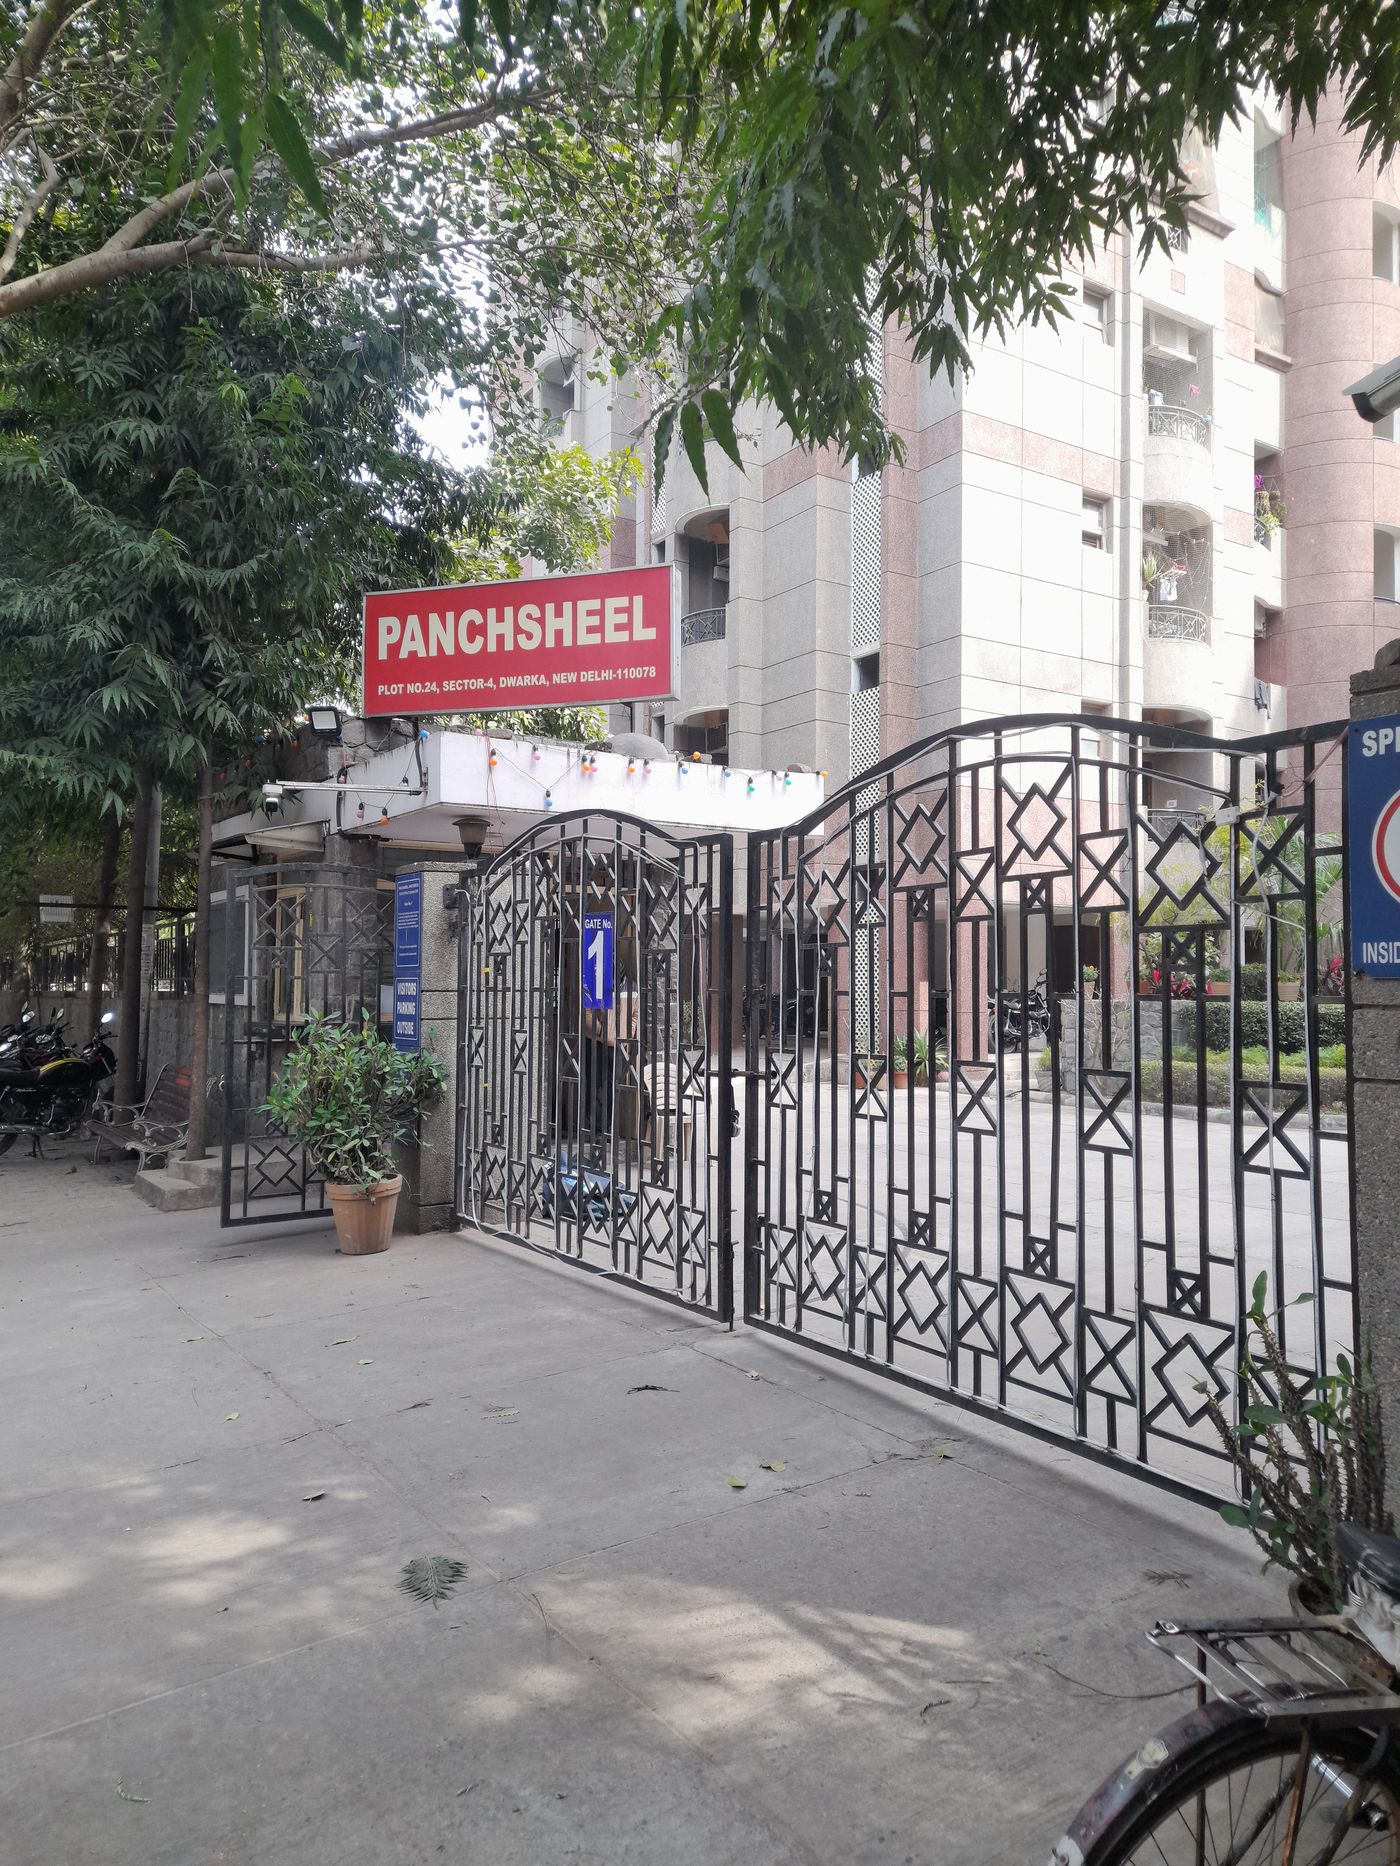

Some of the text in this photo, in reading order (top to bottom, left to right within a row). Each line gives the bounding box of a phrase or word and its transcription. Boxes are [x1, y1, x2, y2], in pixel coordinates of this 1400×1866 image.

[378, 595, 657, 661] PANCHSHEEL
[378, 666, 656, 696] PLOT NO.24, SECTOR-4, DWARKA, NEW DELHI-110078
[584, 919, 613, 929] GATE No.
[588, 930, 604, 1000] 1
[397, 982, 417, 996] VISITORS
[397, 1001, 416, 1015] PARKING
[396, 1021, 414, 1035] OUTSIDE
